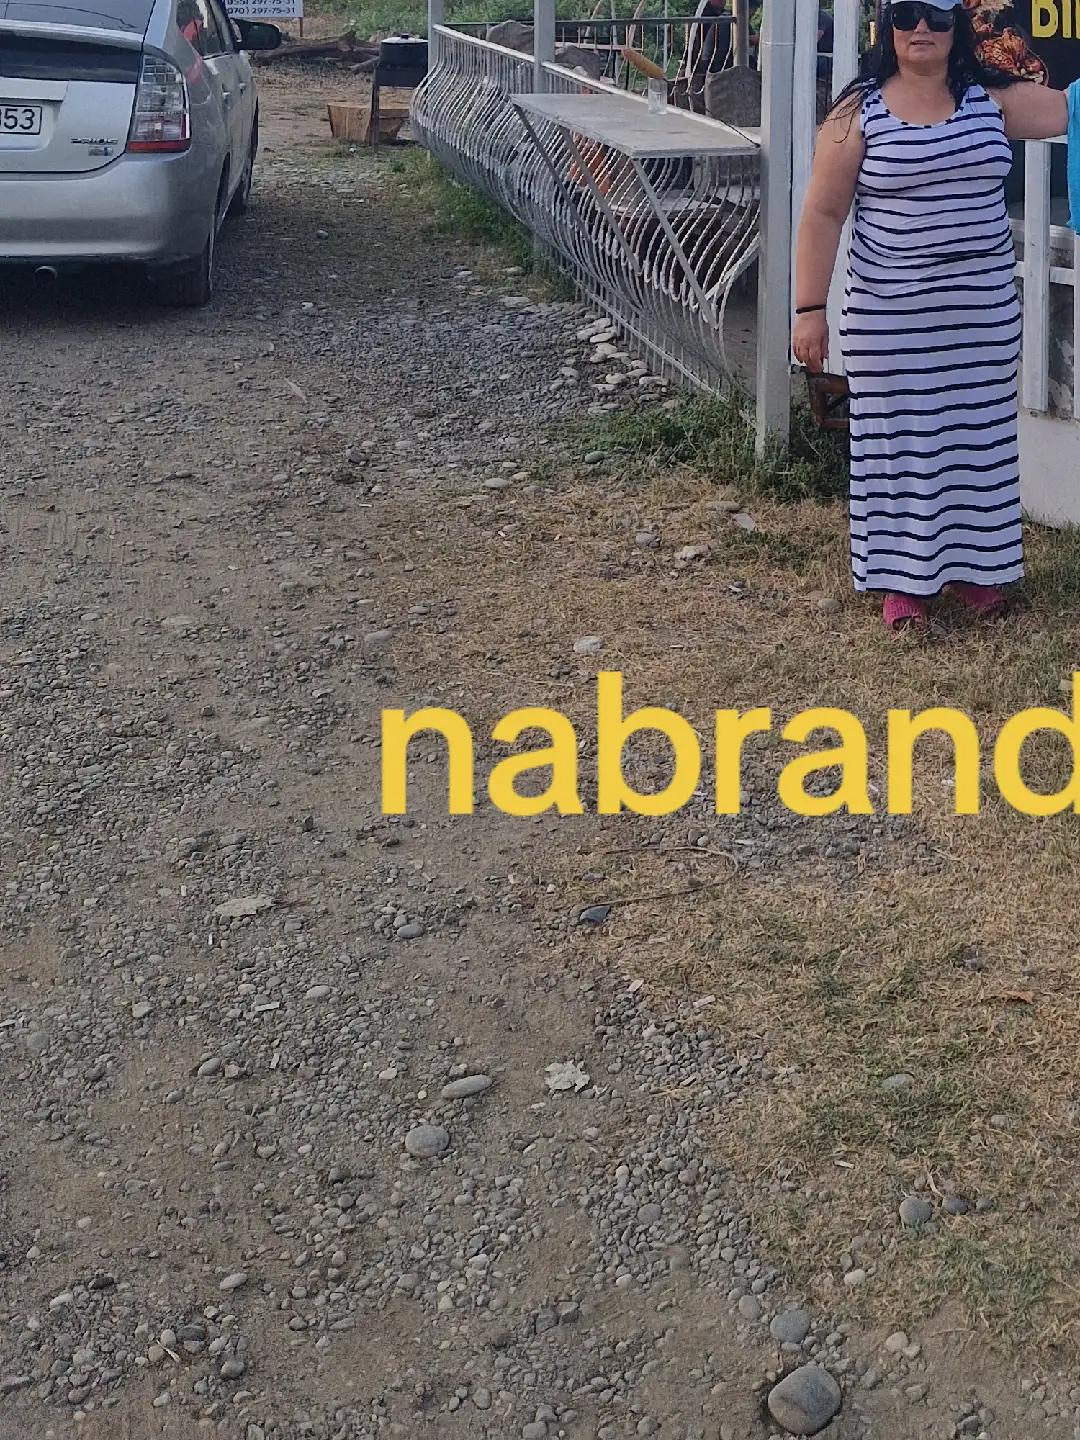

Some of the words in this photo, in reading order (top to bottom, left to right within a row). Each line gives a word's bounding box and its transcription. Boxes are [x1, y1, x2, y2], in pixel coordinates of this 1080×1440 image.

[226, 7, 250, 16] 070)
[251, 6, 296, 15] 297-75-31
[0, 108, 36, 130] 53
